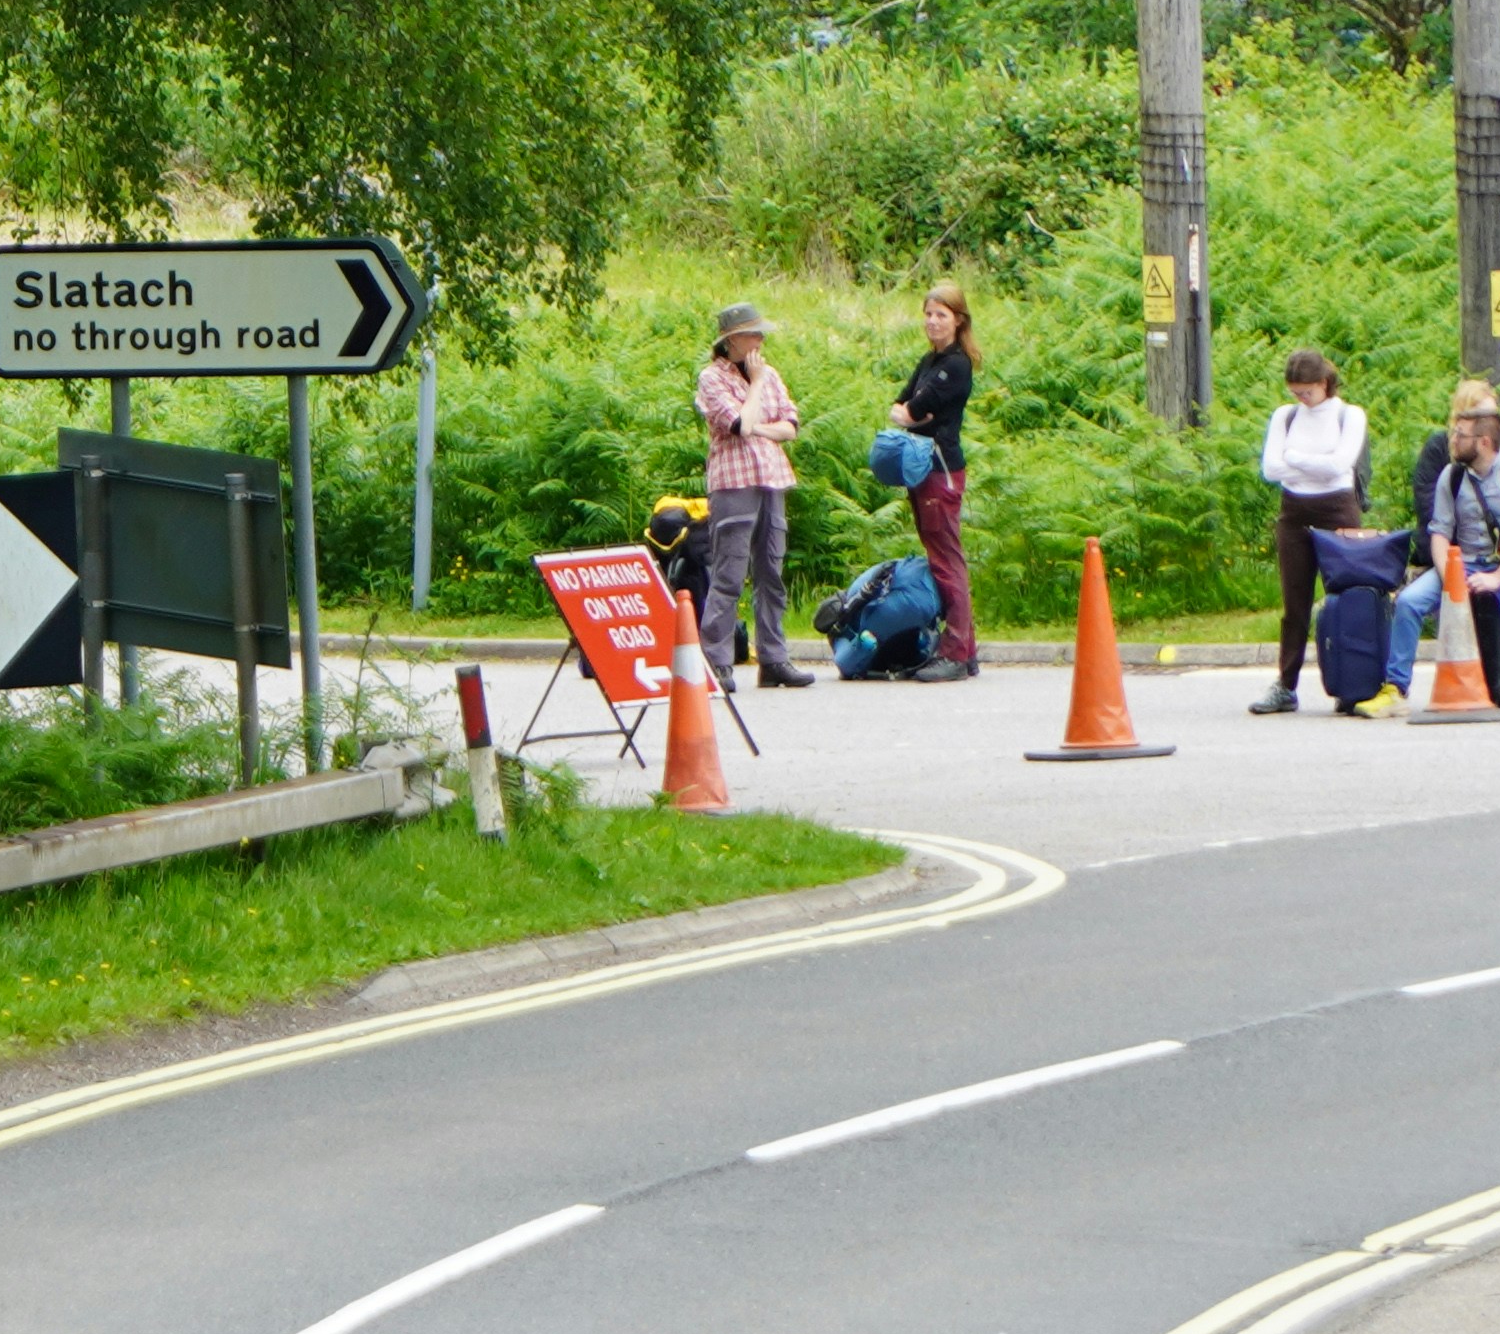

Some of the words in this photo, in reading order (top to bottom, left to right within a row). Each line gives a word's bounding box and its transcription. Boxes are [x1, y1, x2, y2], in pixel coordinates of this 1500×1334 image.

[13, 270, 194, 308] Slatach
[14, 328, 58, 352] no
[72, 320, 222, 356] through
[237, 319, 321, 349] road
[551, 567, 581, 591] NO
[578, 561, 651, 588] PARKING
[583, 596, 614, 620] ON
[609, 593, 650, 617] THIS
[608, 624, 657, 649] ROAD
